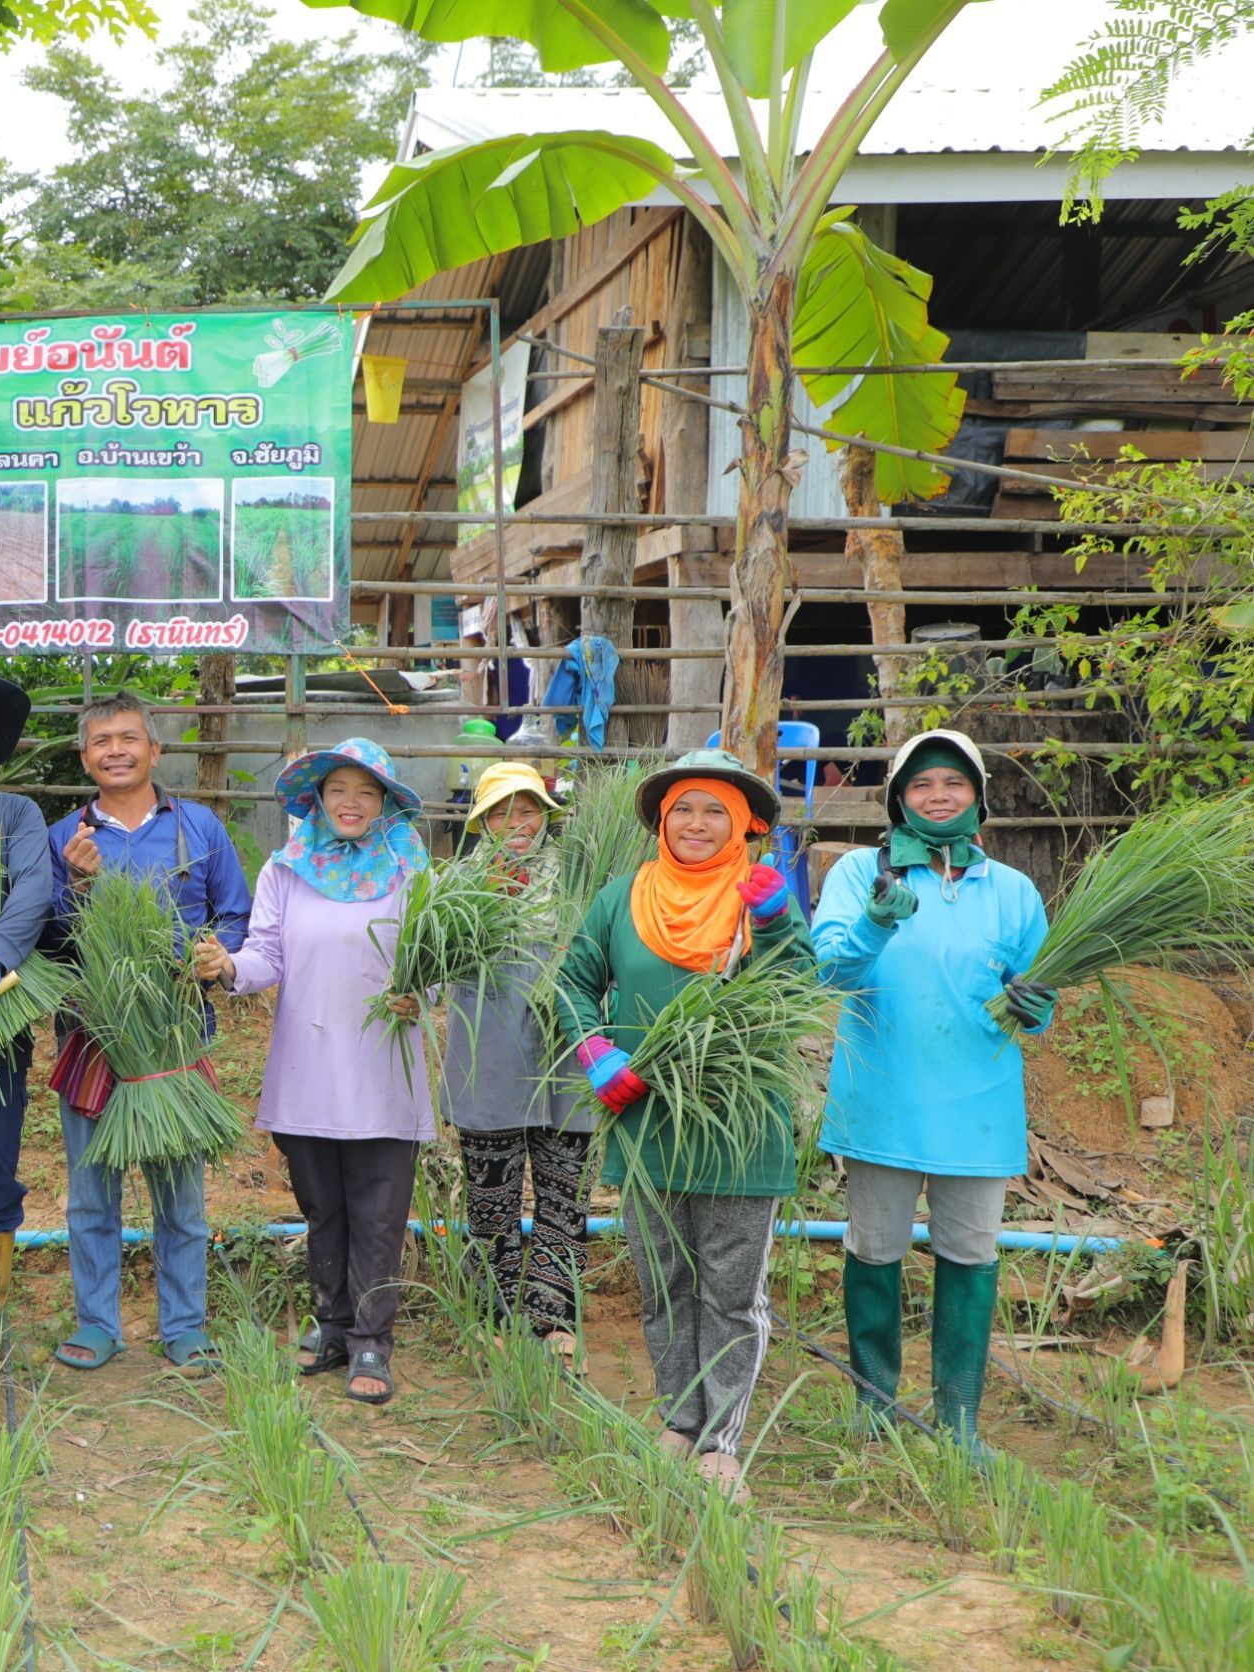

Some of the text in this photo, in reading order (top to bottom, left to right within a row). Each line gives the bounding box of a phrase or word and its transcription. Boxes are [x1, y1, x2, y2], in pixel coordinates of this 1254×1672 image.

[17, 381, 260, 427] แก้วโวหาร
[77, 442, 201, 466] อ.บ้านเขว้า
[231, 442, 322, 471] จ.ชัยภูมิ
